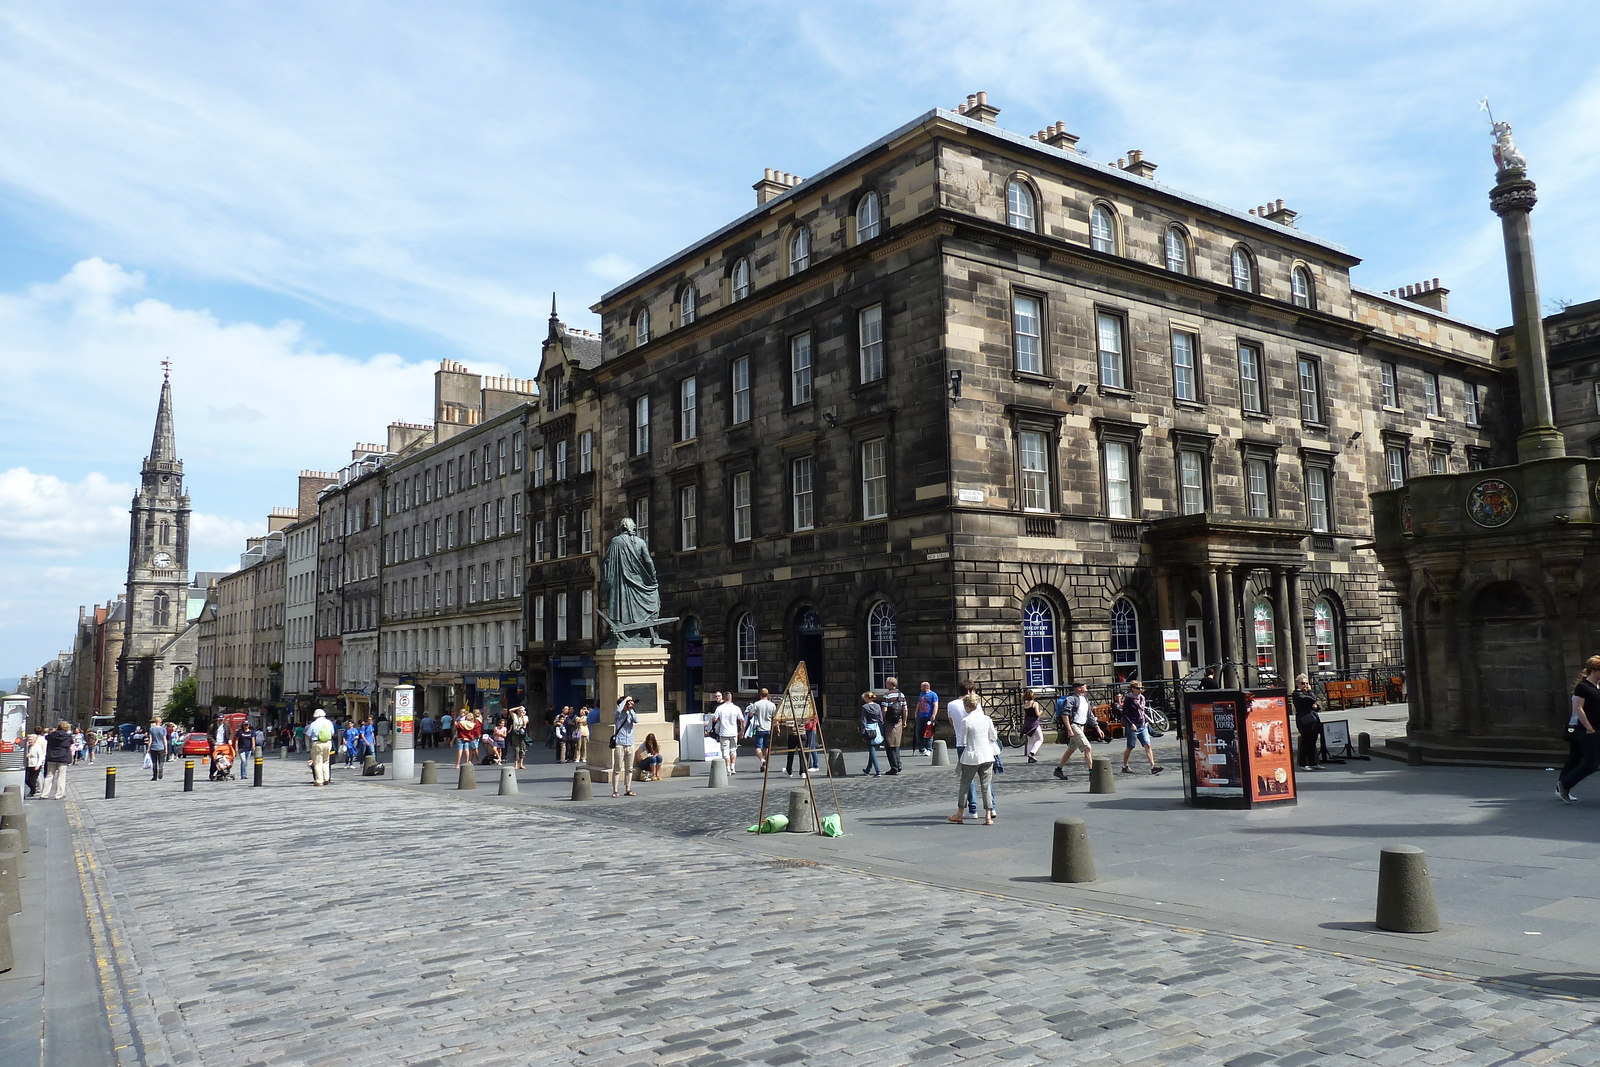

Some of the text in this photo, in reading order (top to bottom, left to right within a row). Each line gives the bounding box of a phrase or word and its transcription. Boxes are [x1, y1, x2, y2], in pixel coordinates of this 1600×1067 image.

[1192, 714, 1213, 722] HISTORY
[1214, 713, 1234, 722] GHOST
[1195, 721, 1212, 729] WALKS
[1215, 721, 1235, 730] TOURS
